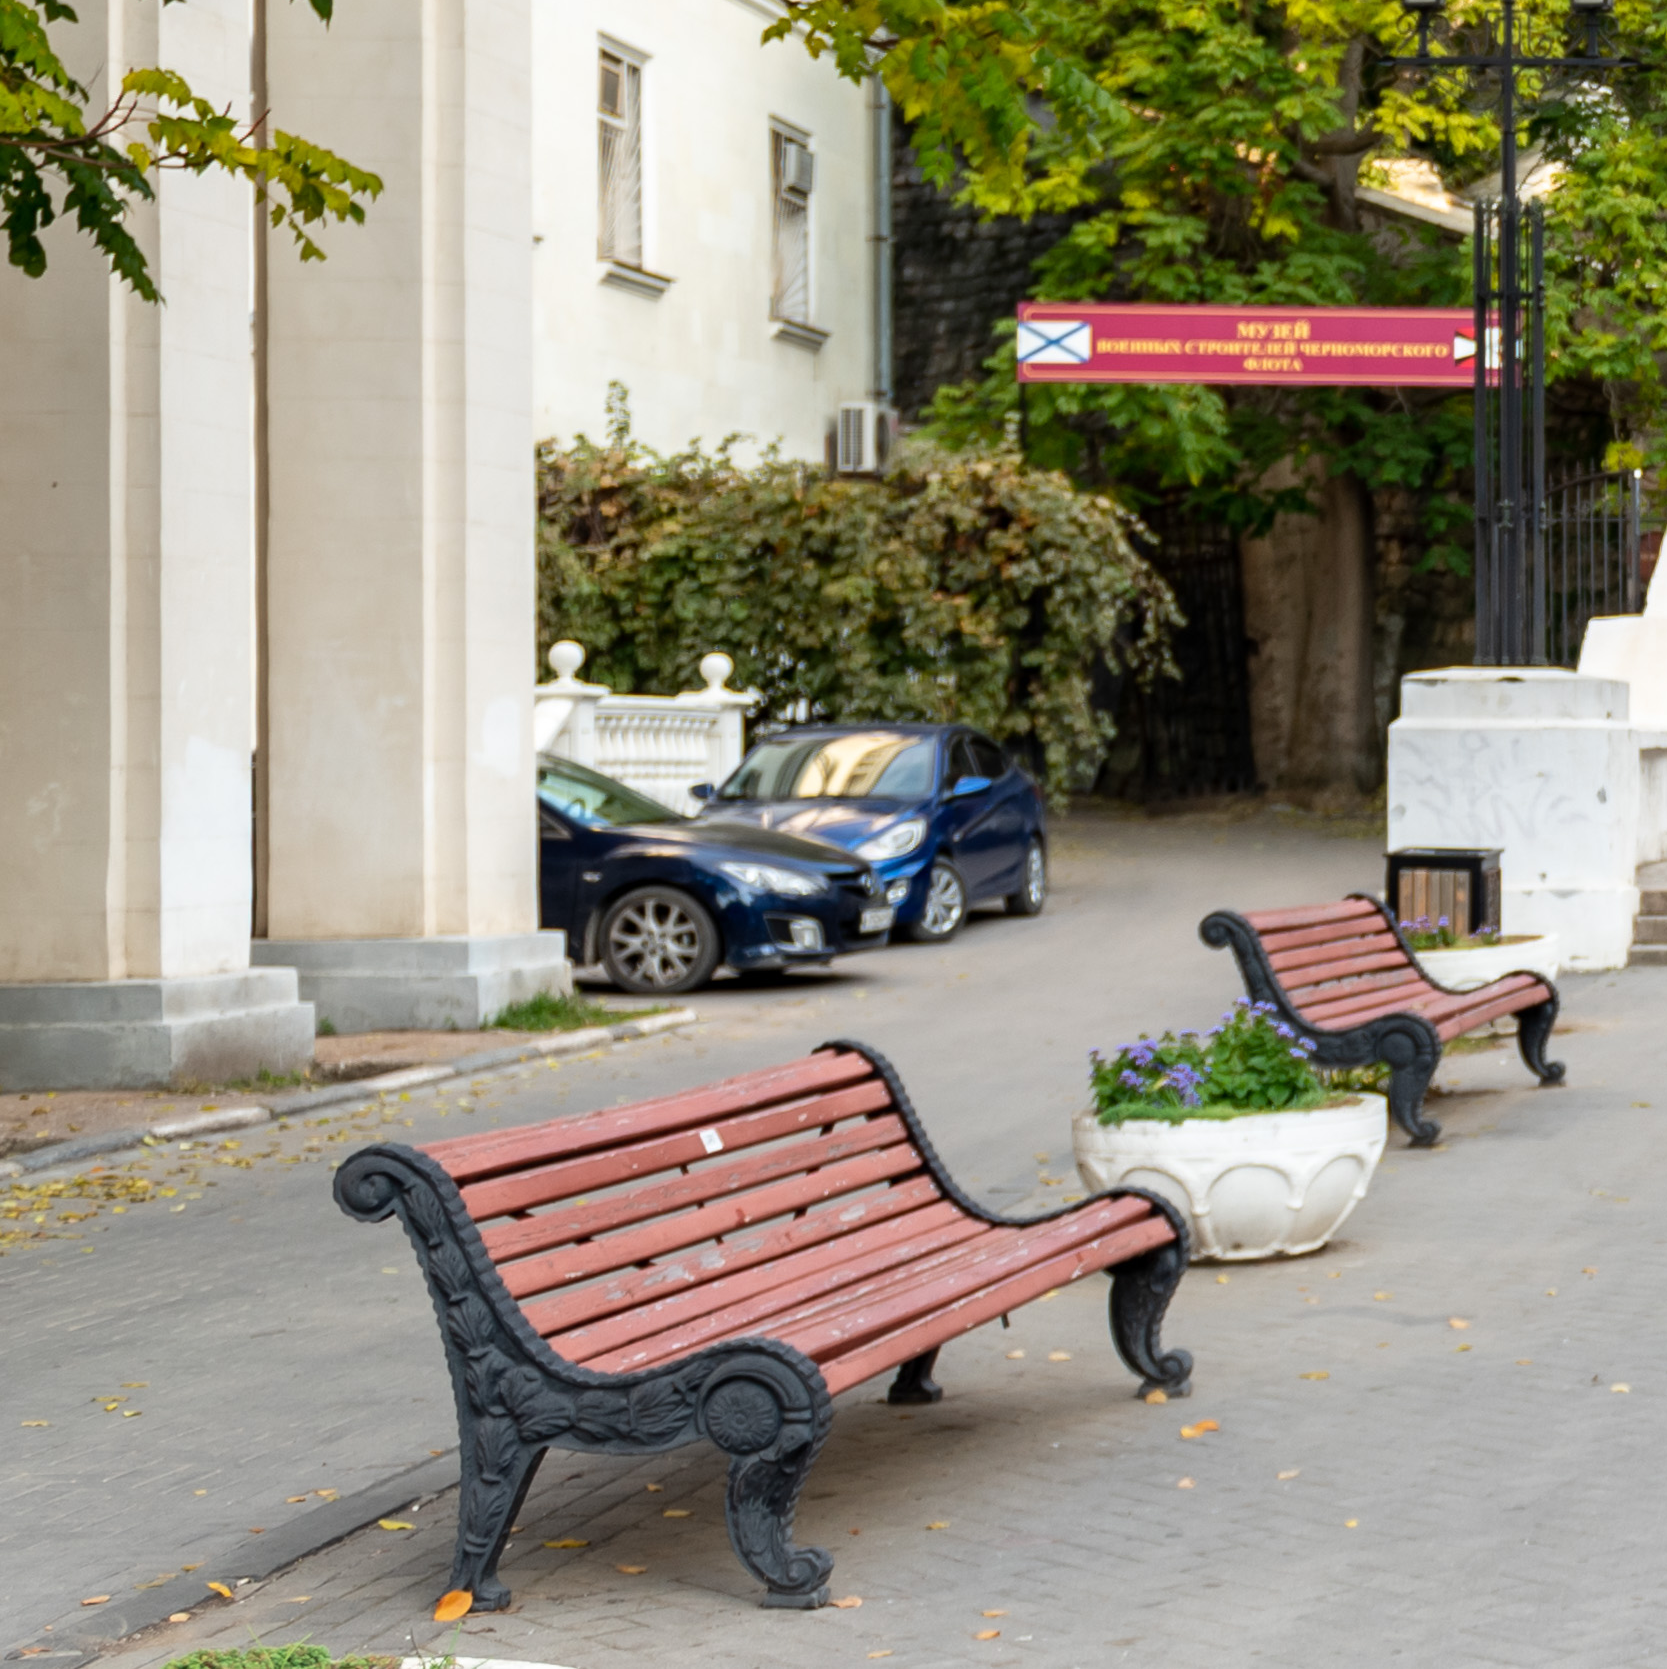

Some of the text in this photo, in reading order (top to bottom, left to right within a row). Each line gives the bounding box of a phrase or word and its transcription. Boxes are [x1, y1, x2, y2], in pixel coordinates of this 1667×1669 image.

[1237, 319, 1311, 340] МУЗЕЙ
[1097, 338, 1450, 358] ВОЕННЫХ СТРОИТЕЛЕЙ ЧЕРНОМОРСКОГО
[1243, 357, 1304, 372] ФЛОТА
